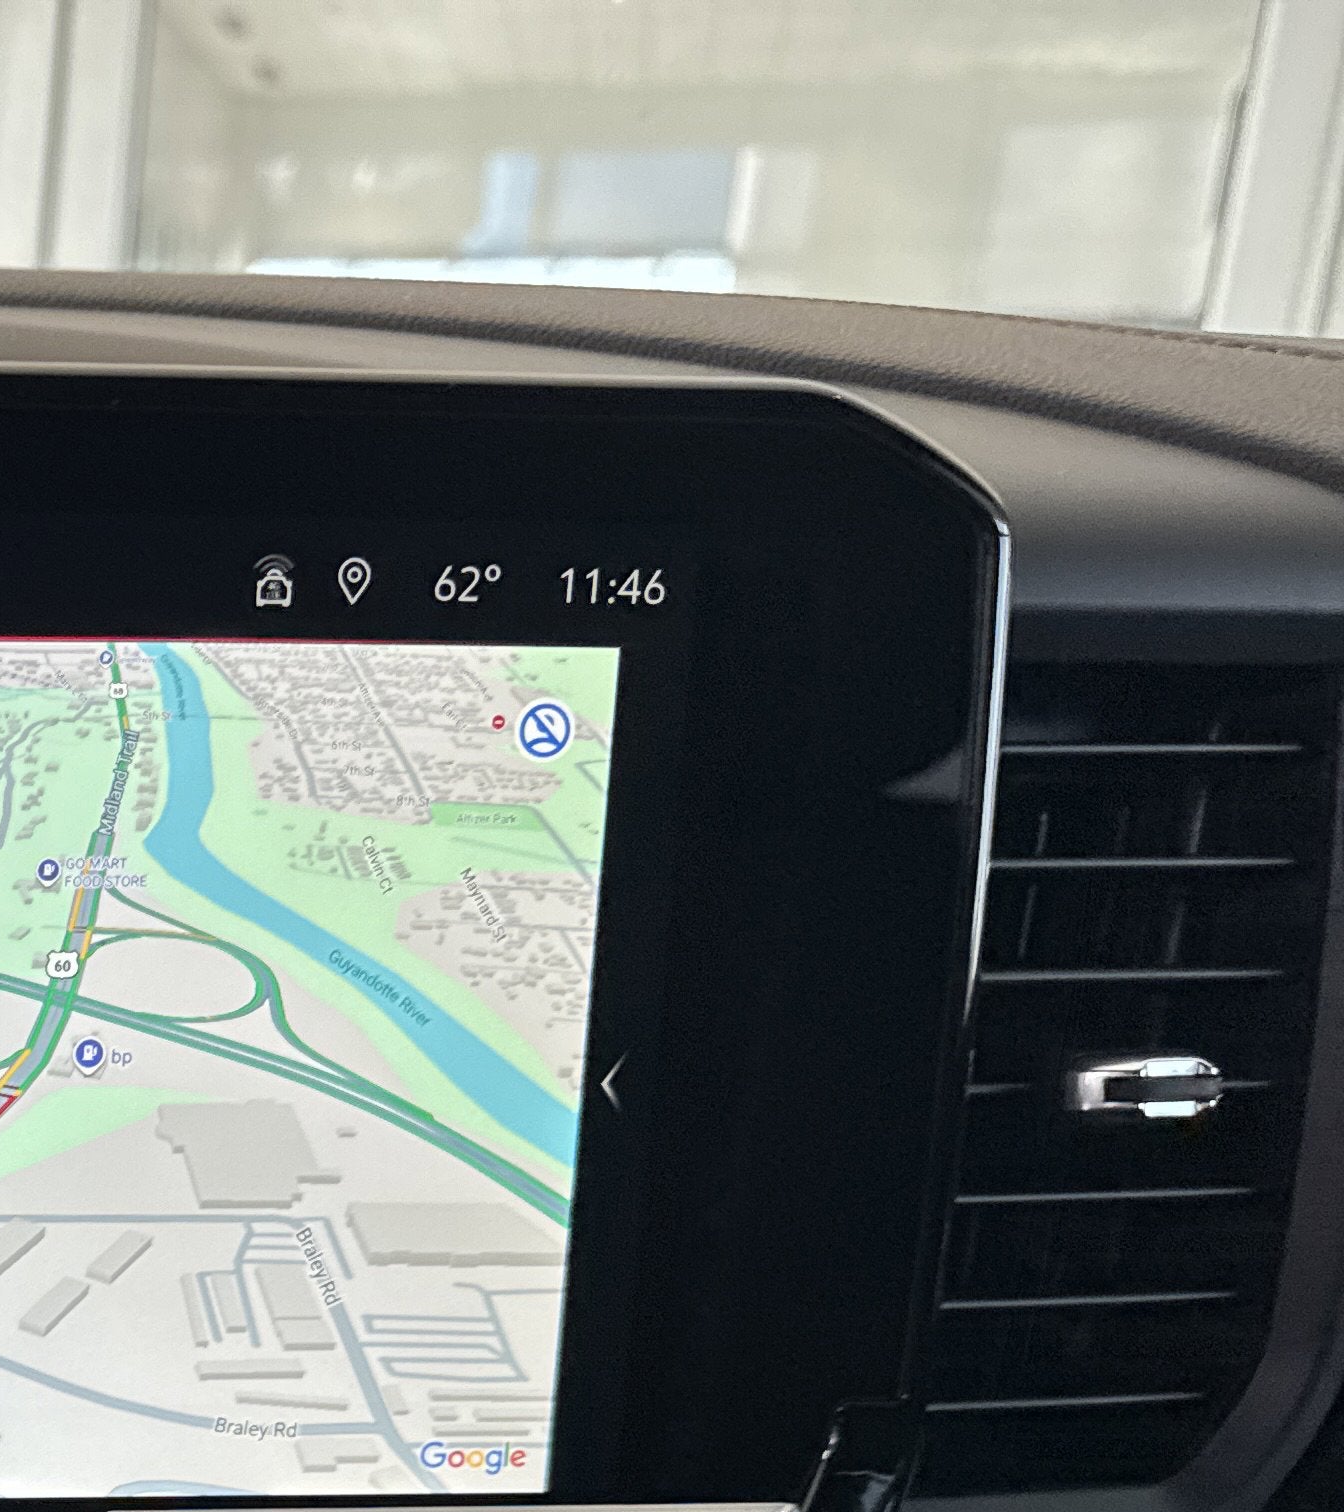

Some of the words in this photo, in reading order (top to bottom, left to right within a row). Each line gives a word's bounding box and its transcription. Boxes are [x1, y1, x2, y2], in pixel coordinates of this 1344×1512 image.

[559, 567, 667, 606] 11:46
[99, 768, 129, 837] Midland
[116, 730, 140, 766] Trail
[493, 813, 517, 824] Park
[64, 875, 104, 888] FOOD
[105, 875, 148, 888] STORE
[66, 858, 85, 870] GO
[90, 858, 127, 870] MART
[362, 835, 386, 879] Calvin
[378, 877, 393, 895] Ct
[460, 867, 497, 928] Maynard
[491, 923, 507, 943] St
[54, 959, 72, 973] 60
[327, 948, 400, 1004] Guyandotte
[397, 997, 432, 1028] River
[111, 1048, 133, 1066] bp
[295, 1226, 328, 1279] Braley
[318, 1280, 342, 1306] Rd
[214, 1416, 268, 1441] Braley
[273, 1419, 297, 1439] Rd
[419, 1441, 528, 1476] Google
